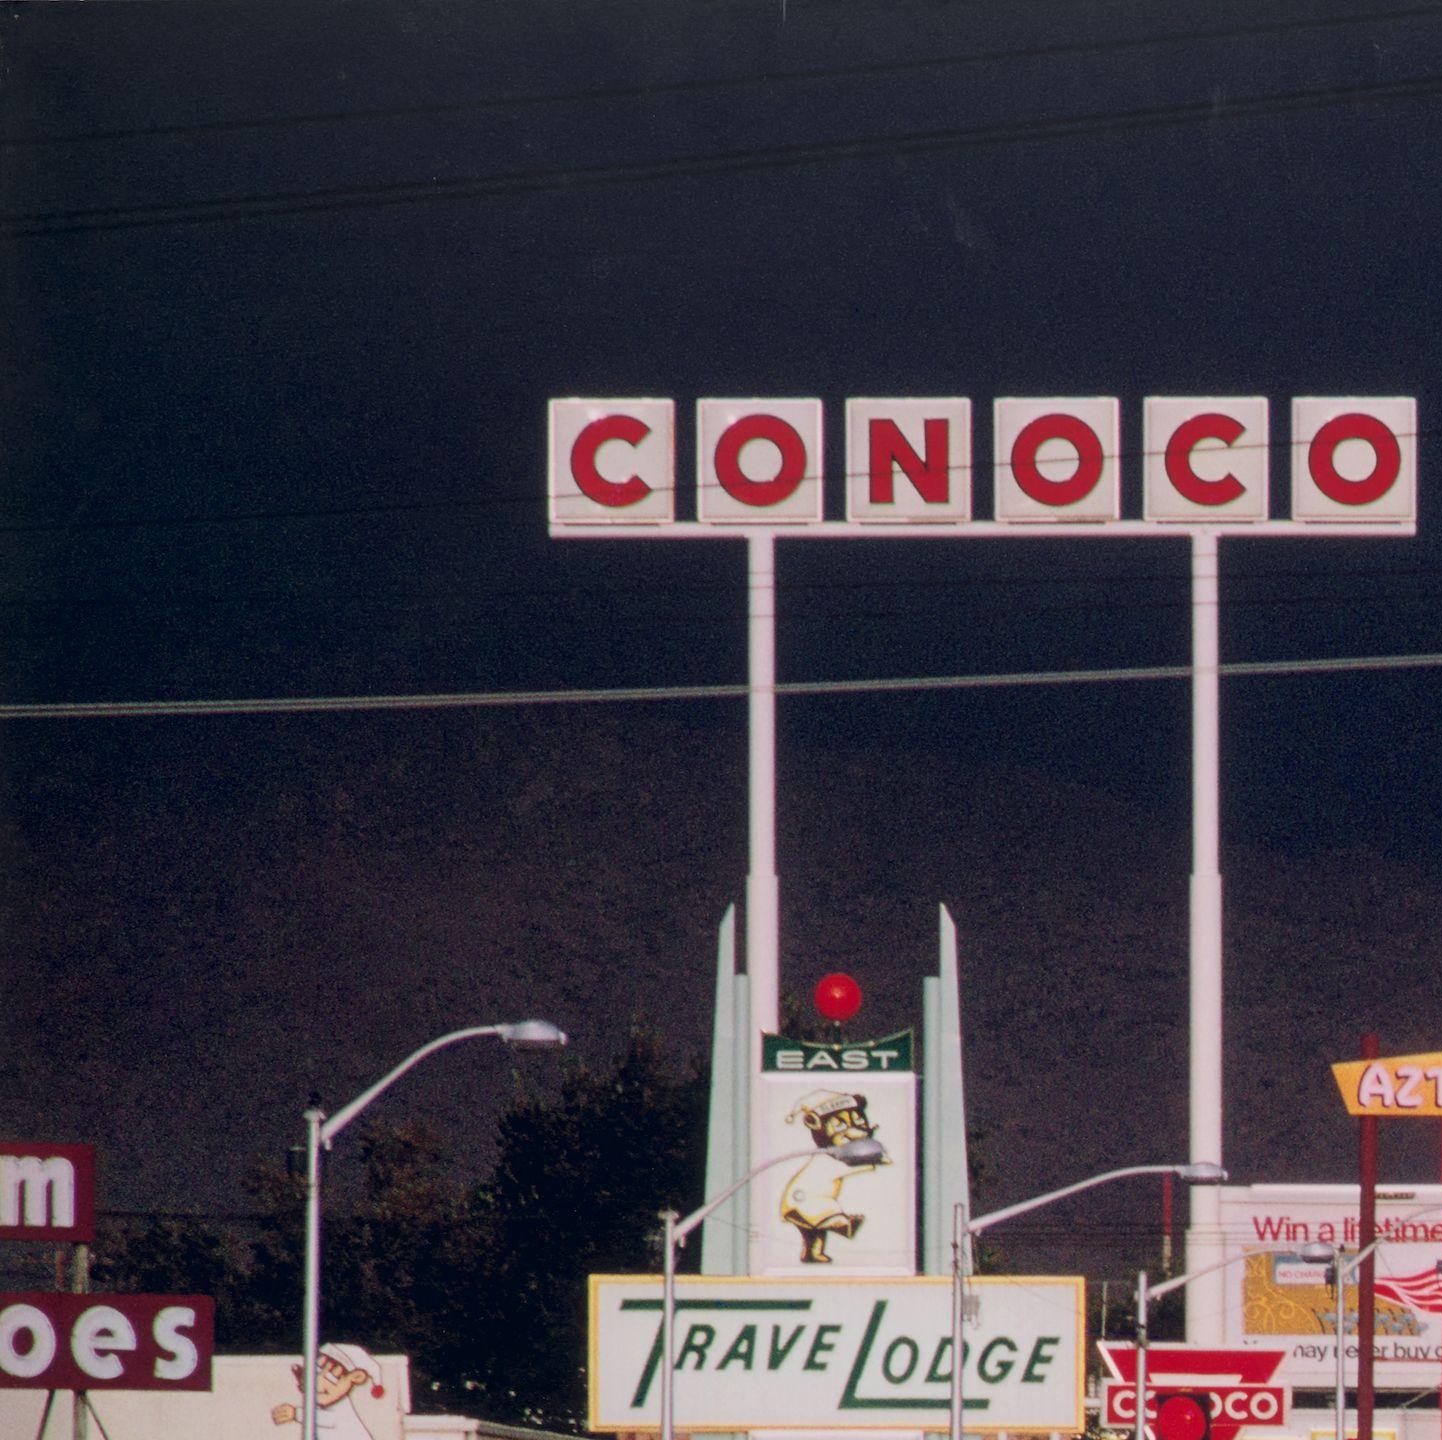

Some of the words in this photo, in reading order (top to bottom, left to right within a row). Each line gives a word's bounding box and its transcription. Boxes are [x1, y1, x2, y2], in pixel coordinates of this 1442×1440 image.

[570, 411, 1402, 508] CONOCO
[776, 1050, 898, 1070] EAST
[1252, 1215, 1308, 1242] Win
[1317, 1221, 1335, 1242] a
[1113, 1390, 1279, 1421] COCO
